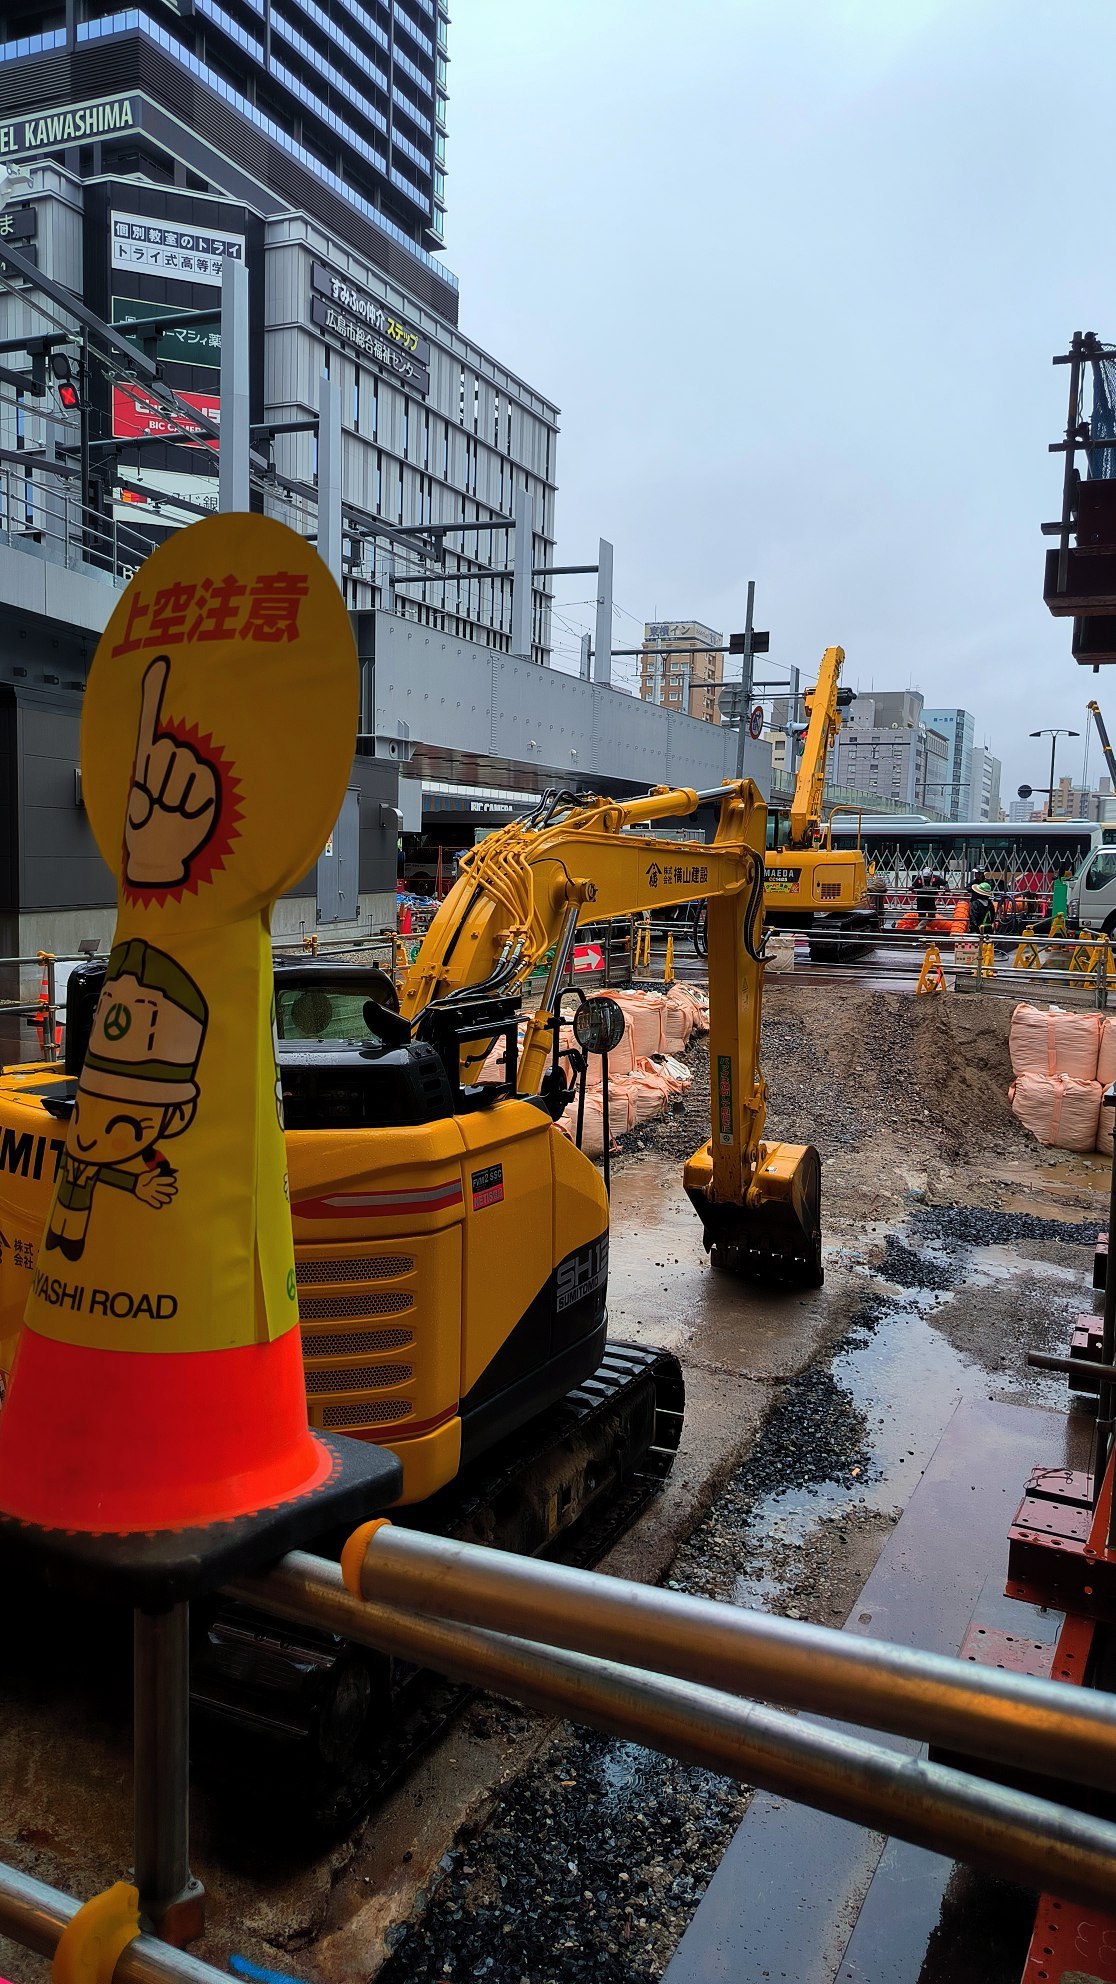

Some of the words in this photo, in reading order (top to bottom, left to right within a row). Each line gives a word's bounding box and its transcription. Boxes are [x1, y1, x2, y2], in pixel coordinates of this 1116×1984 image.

[25, 100, 133, 147] KAWASHIMA
[115, 222, 239, 258] 個別教室のトライ
[331, 277, 385, 331] すみふの仲介
[386, 317, 418, 351] ステップ
[325, 309, 421, 378] 広島市総合福祉センター
[149, 421, 166, 431] BIC
[112, 571, 309, 659] 上空注意
[648, 625, 691, 637] 東横イン
[674, 866, 708, 884] 横山建設
[764, 869, 794, 878] MAEDA
[0, 1126, 66, 1184] MIT
[489, 1169, 502, 1181] SSC
[89, 1289, 178, 1320] ROAD
[558, 1276, 599, 1310] SUMITOMO
